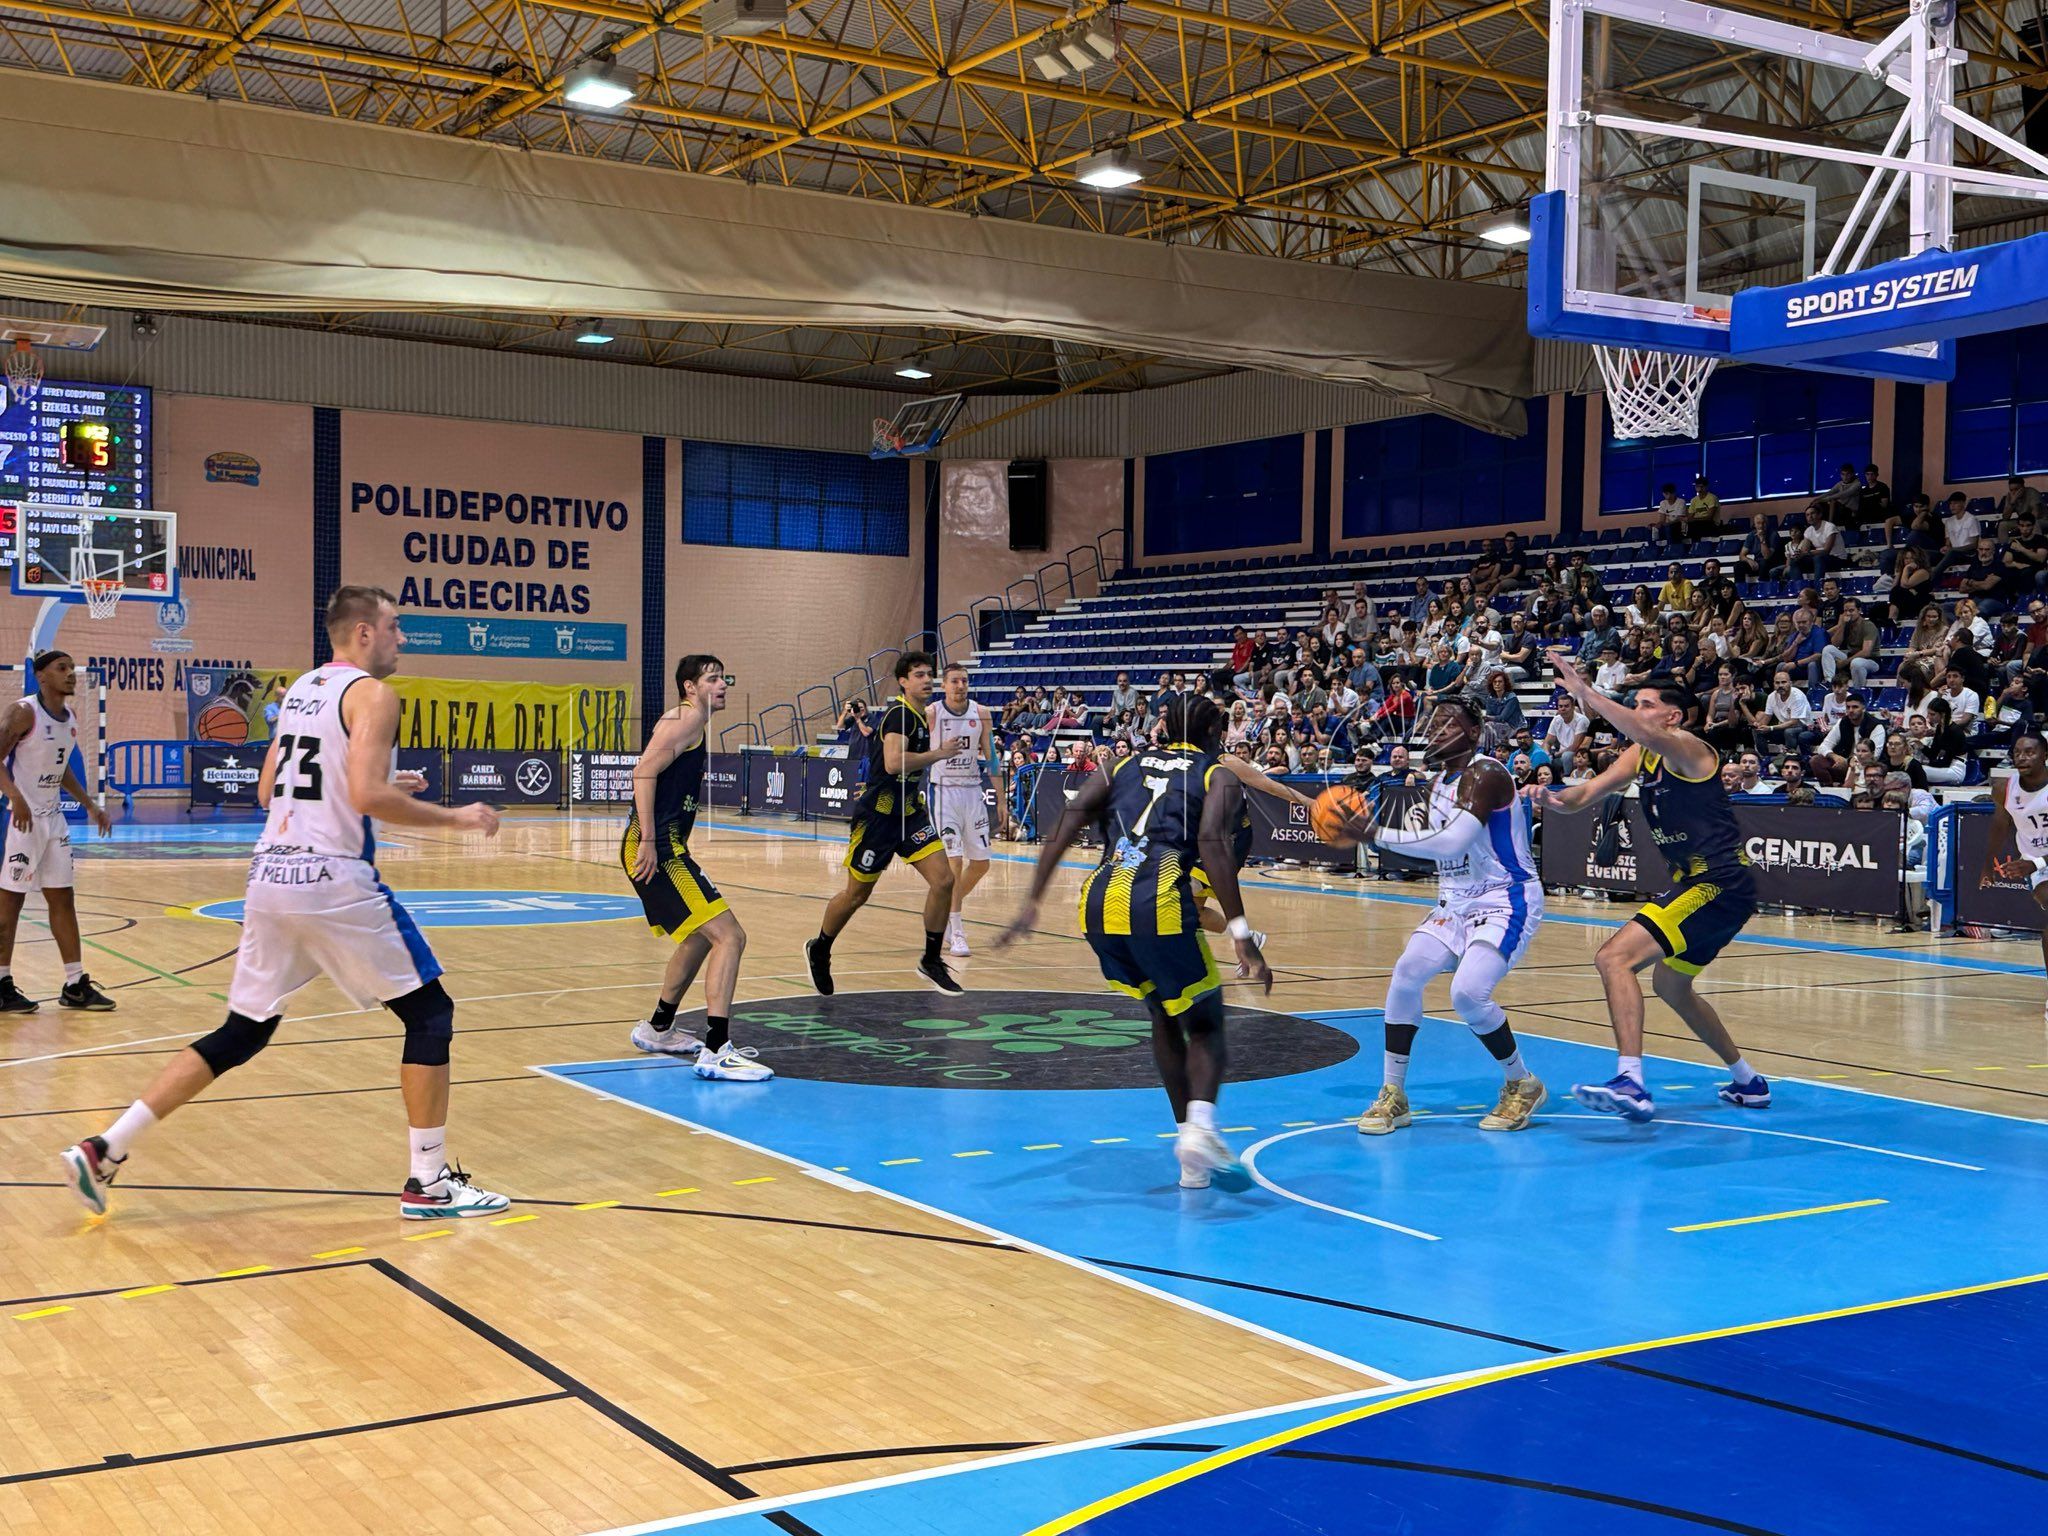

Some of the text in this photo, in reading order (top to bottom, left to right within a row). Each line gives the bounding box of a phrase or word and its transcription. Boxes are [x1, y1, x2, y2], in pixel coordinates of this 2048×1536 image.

[30, 400, 38, 411] 3
[41, 402, 72, 413] EZEKIEL
[82, 405, 106, 416] ALLEY
[134, 409, 142, 420] 7
[30, 416, 38, 427] 4
[41, 417, 61, 428] LUIS
[134, 423, 142, 435] 3
[30, 431, 38, 442] 8
[28, 446, 40, 457] 10
[93, 441, 108, 466] 5
[28, 461, 40, 472] 12
[28, 477, 40, 488] 13
[27, 492, 41, 504] 23
[351, 482, 629, 532] POLIDEPORTIVO
[2, 512, 16, 530] 5
[28, 522, 40, 533] 44
[403, 531, 591, 571] CIUDAD DE
[179, 546, 256, 581] MUNICIPAL
[398, 576, 592, 615] ALGECIRAS
[89, 657, 165, 691] DEPORTES
[514, 702, 562, 752] DEL
[576, 688, 627, 752] SUR
[56, 748, 65, 764] 3
[206, 770, 256, 780] Heineken
[274, 734, 323, 801] 23
[591, 770, 607, 779] CERO
[573, 763, 583, 800] AMBAR
[591, 780, 607, 790] CERO
[591, 790, 607, 800] CERO
[1132, 774, 1170, 837] 7
[861, 849, 876, 867] 6
[1745, 836, 1879, 870] CENTRAL
[261, 864, 333, 884] MELILLA
[1586, 865, 1637, 881] EVENTS
